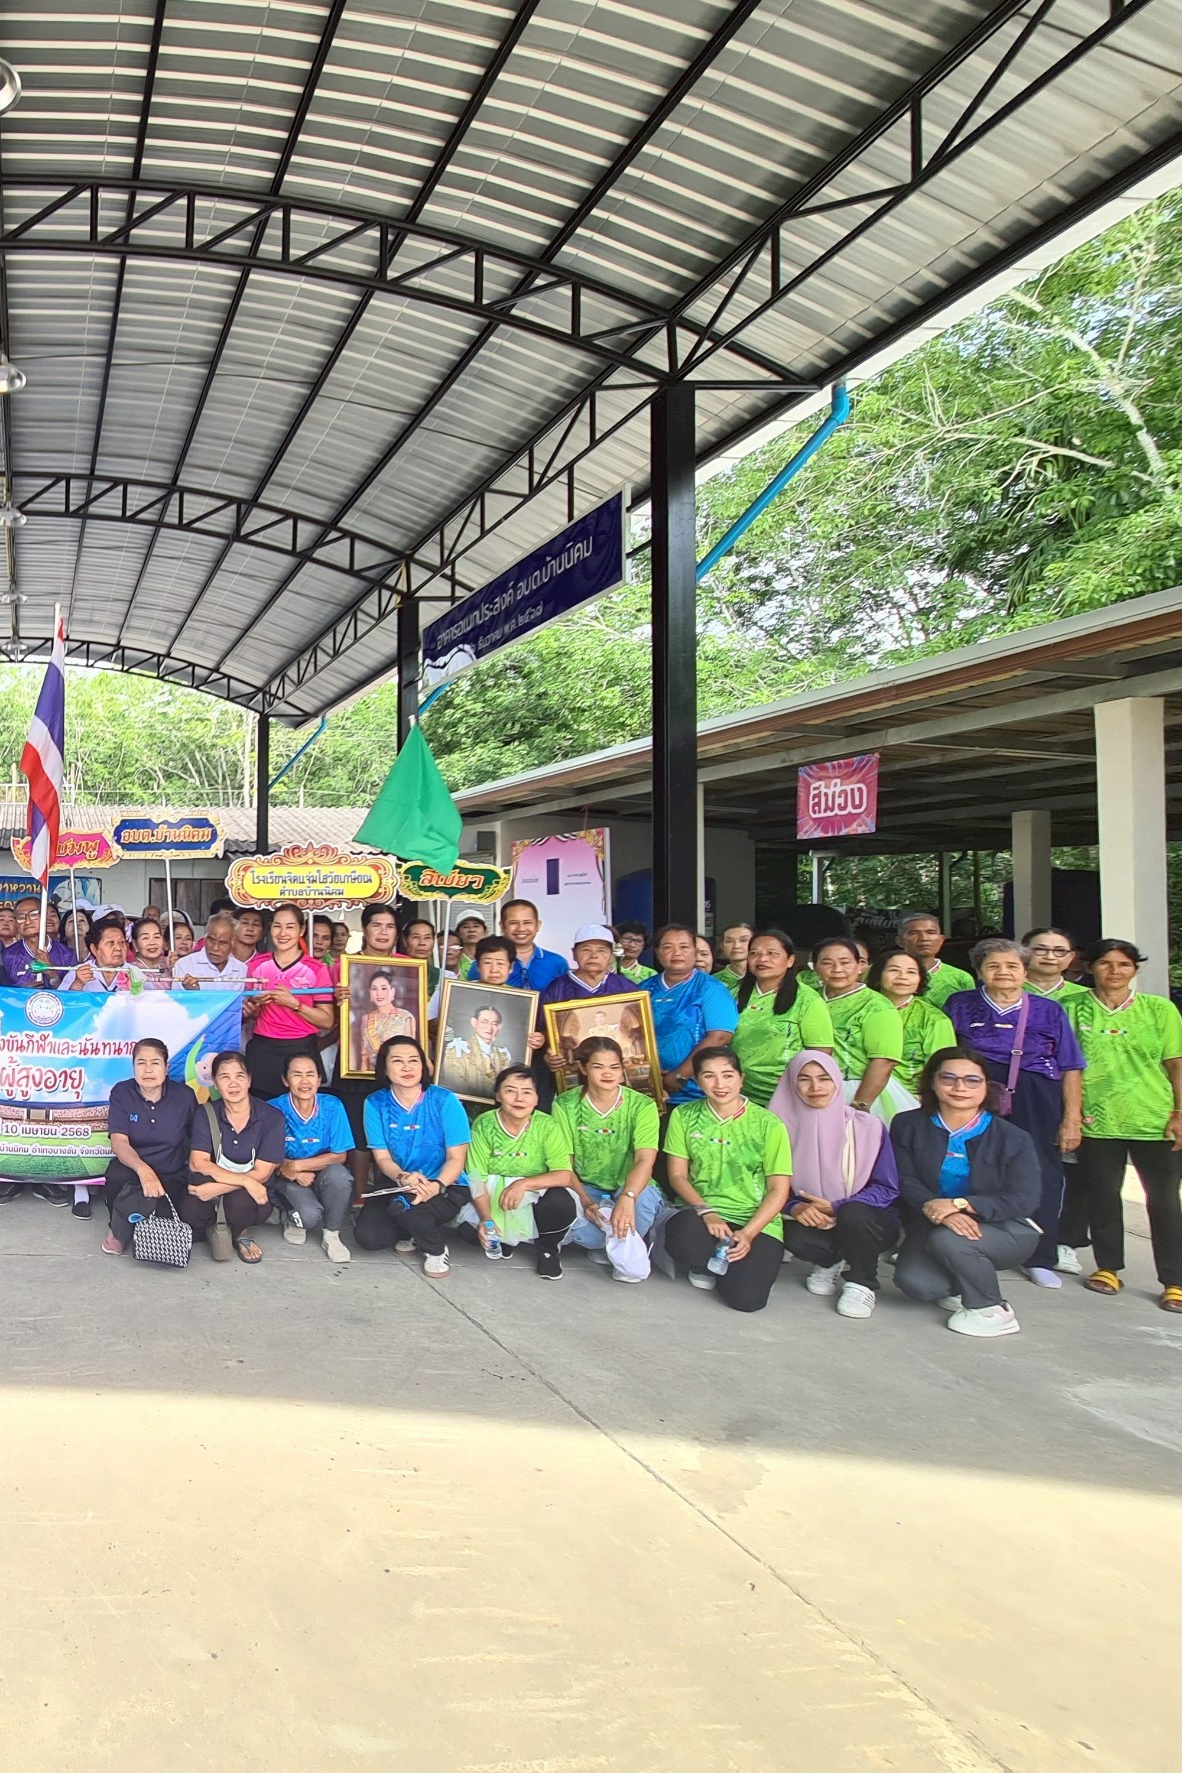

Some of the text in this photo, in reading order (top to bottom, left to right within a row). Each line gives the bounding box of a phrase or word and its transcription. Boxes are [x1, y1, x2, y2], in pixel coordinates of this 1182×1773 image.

[809, 778, 867, 818] สีม่วง
[0, 1056, 83, 1099] ผู้สูงอายุ
[4, 1124, 18, 1134] 10
[21, 1126, 57, 1136] เมษายน
[61, 1127, 90, 1137] 2568
